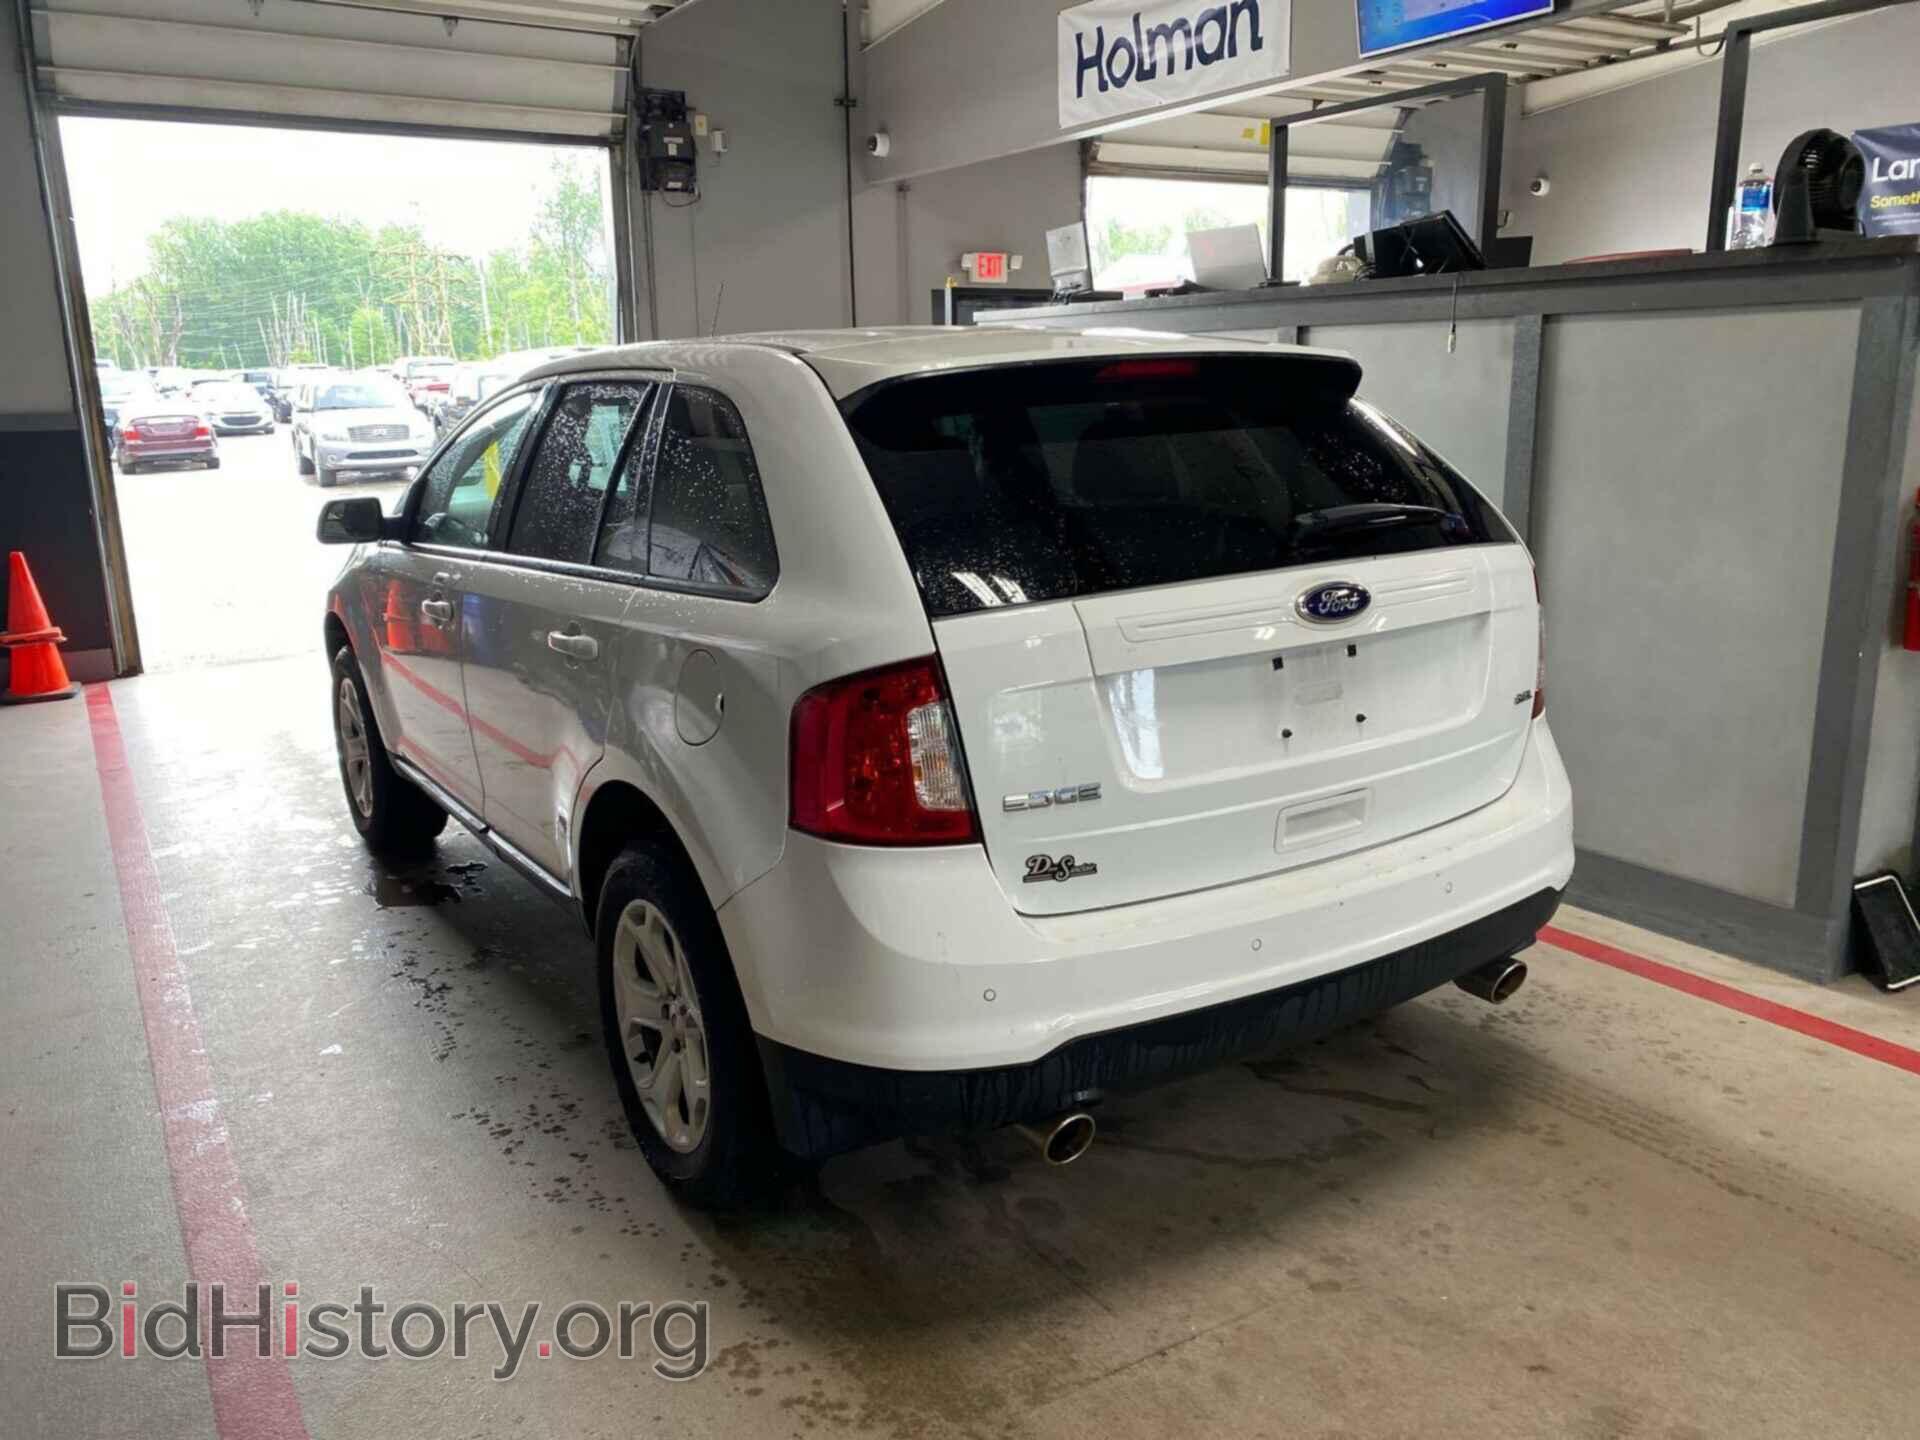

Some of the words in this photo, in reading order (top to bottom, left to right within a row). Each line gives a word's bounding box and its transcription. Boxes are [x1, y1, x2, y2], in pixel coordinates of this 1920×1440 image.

[1075, 0, 1263, 99] Holman
[977, 254, 1003, 278] EXIT
[1318, 588, 1361, 614] Ford
